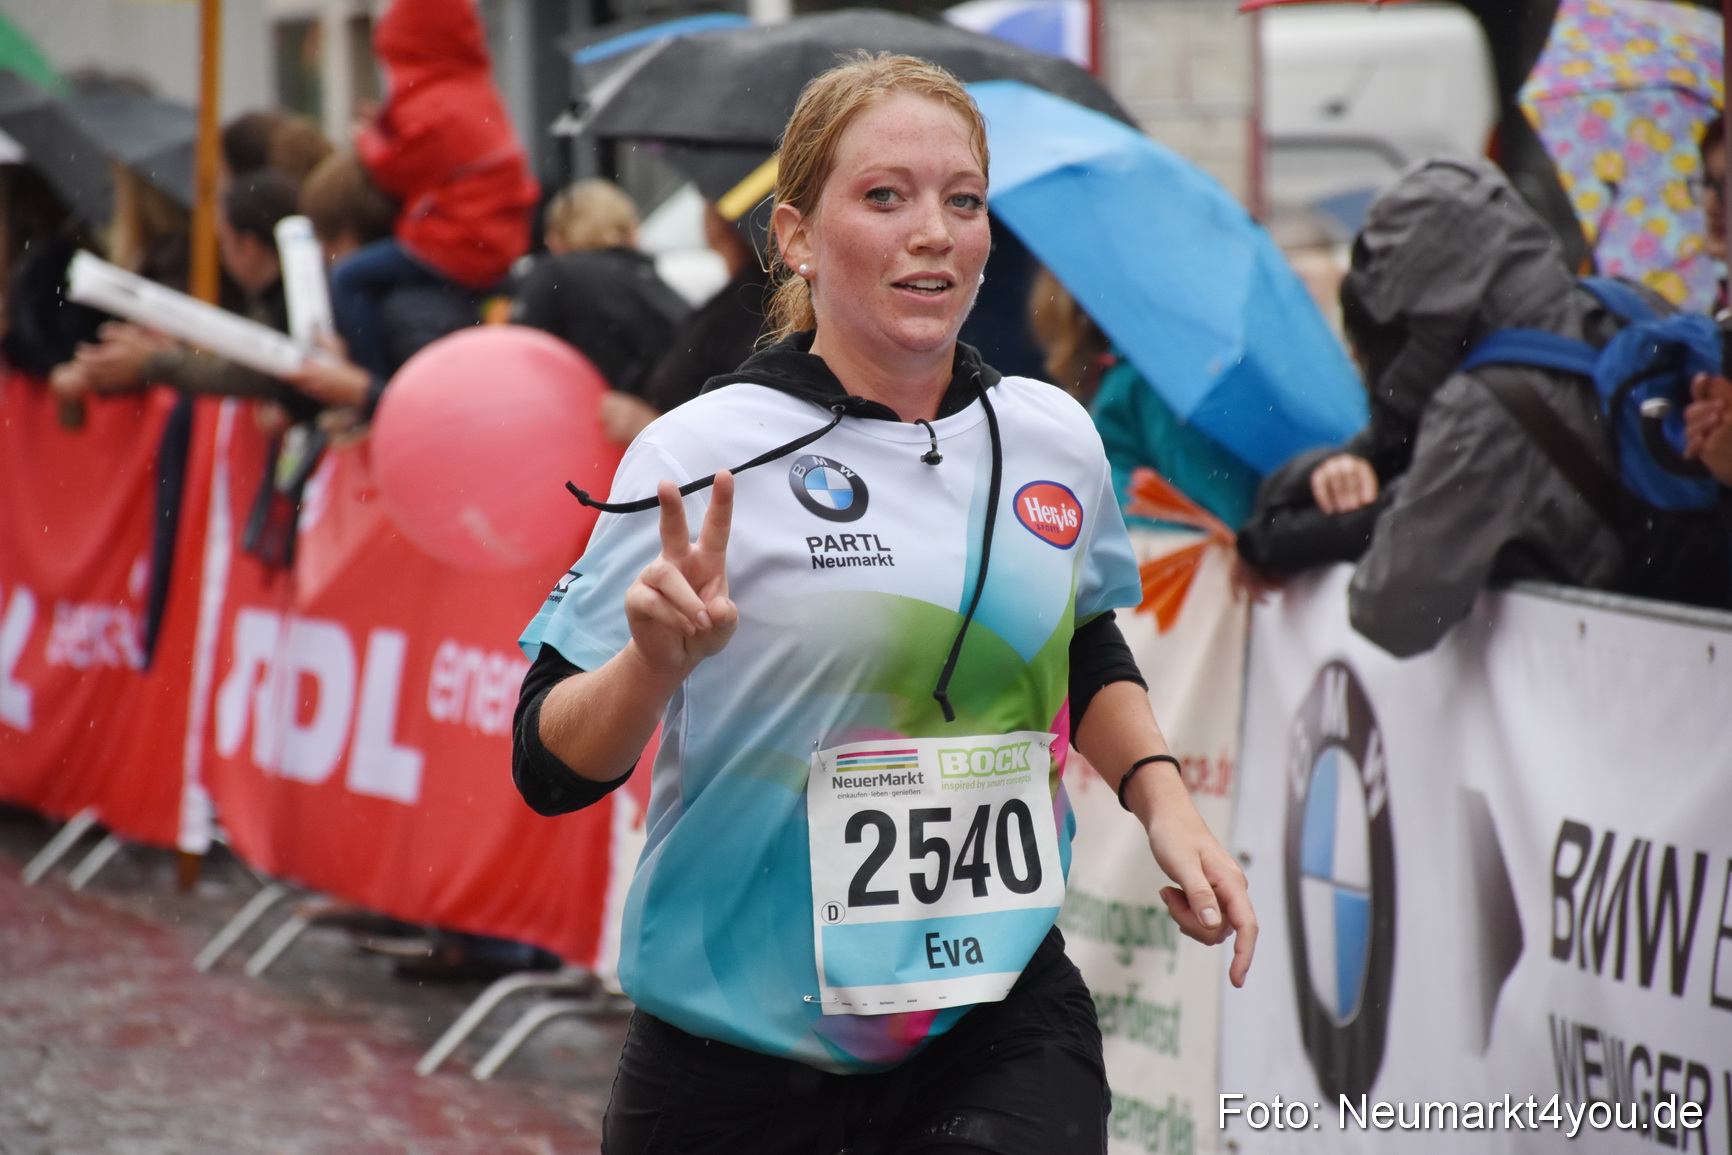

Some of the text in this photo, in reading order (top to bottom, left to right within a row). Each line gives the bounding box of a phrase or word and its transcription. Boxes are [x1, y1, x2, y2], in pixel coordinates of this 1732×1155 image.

[791, 455, 856, 479] BMW
[1023, 496, 1078, 532] Hervis
[1036, 523, 1060, 534] SPORTS
[805, 533, 891, 554] PARTL
[811, 553, 895, 569] Neumarkt
[937, 741, 1032, 778] BOCK
[832, 772, 924, 789] NeuerMarkt
[941, 774, 1031, 792] inspired by smart concepts
[837, 790, 868, 799] einkaufen
[892, 788, 921, 797] genießen
[845, 798, 1042, 907] 2540
[828, 904, 839, 921] D
[1551, 817, 1708, 998] BMW
[925, 932, 984, 970] Eva
[1548, 1011, 1714, 1155] WENIGER
